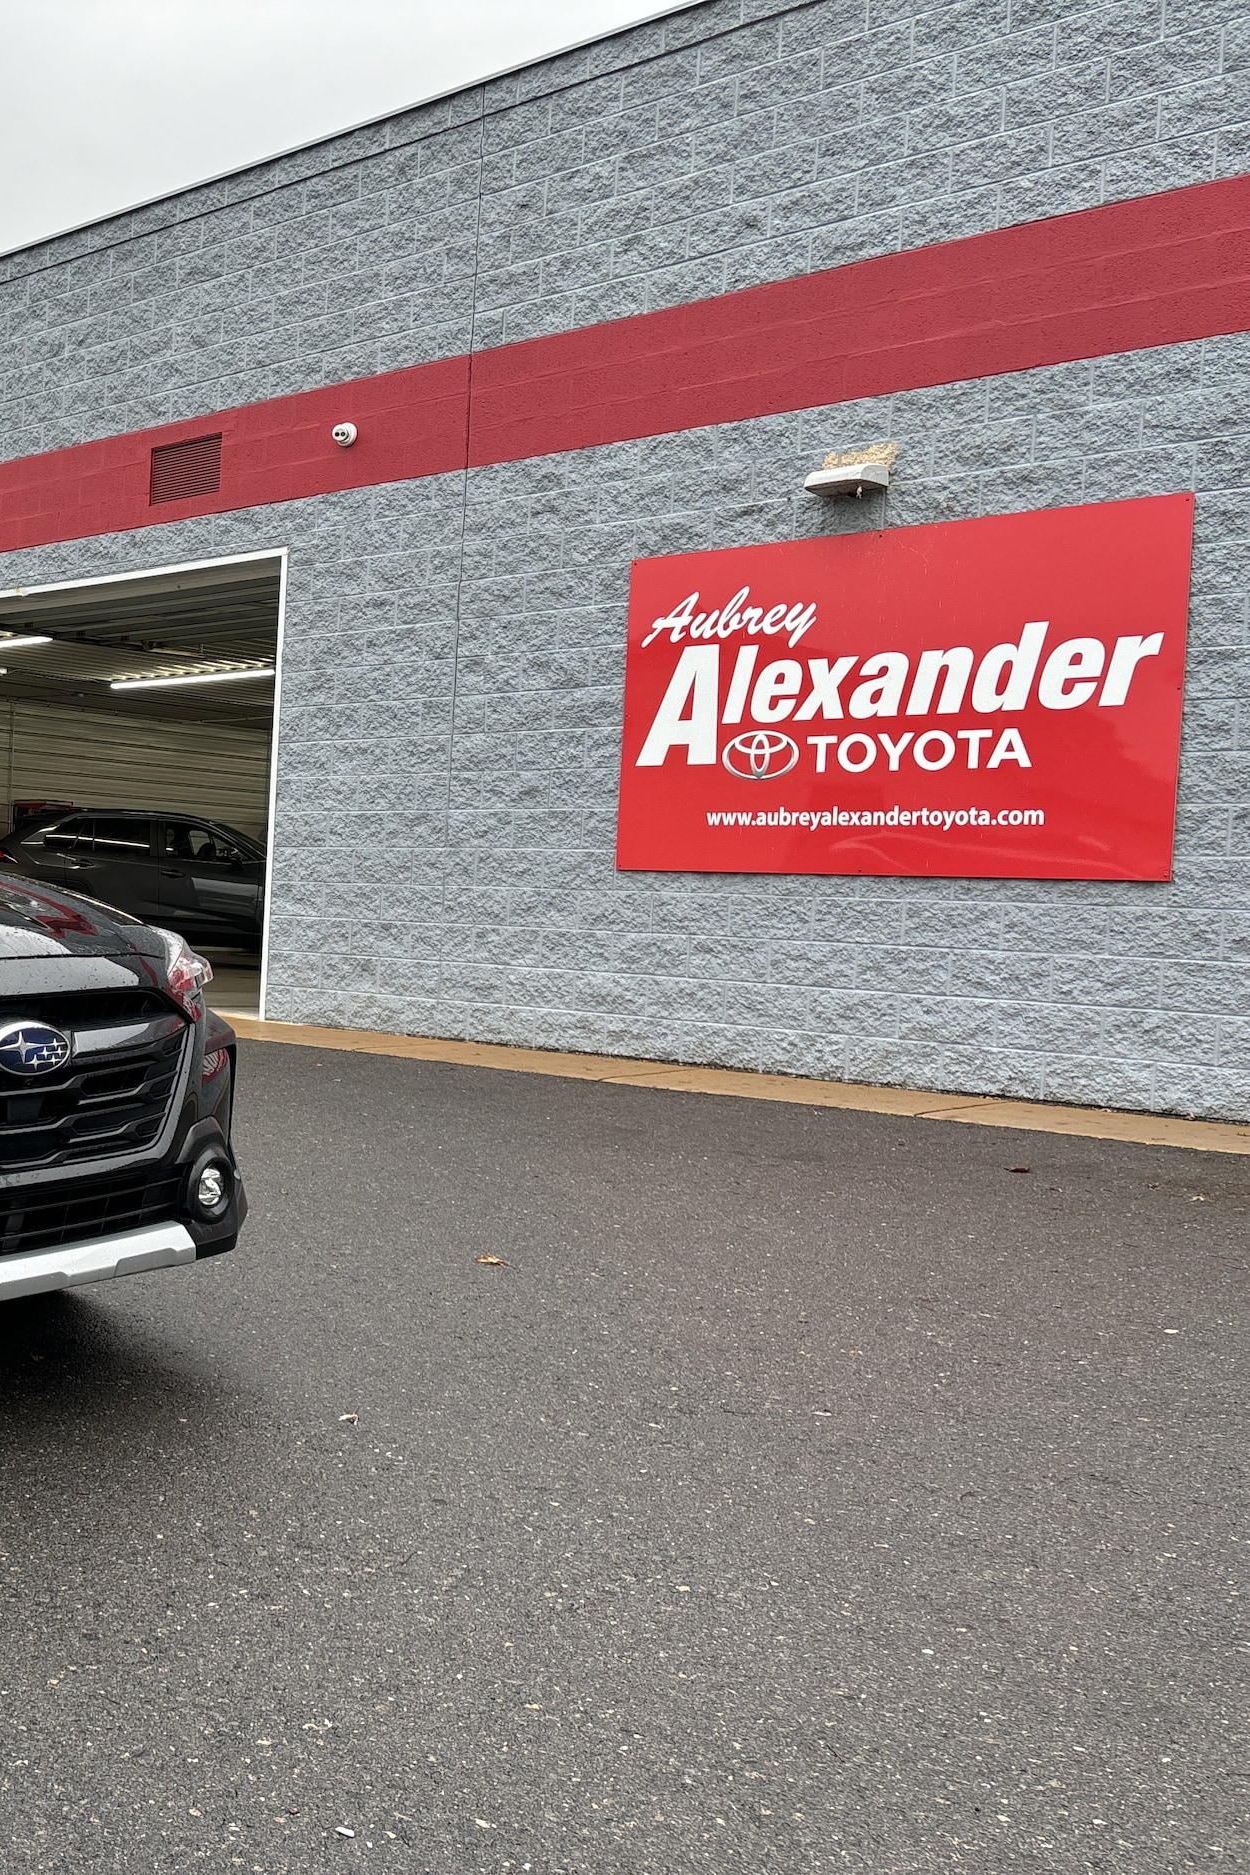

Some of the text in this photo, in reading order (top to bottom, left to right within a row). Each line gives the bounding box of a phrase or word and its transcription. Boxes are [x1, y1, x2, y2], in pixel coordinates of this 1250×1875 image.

[641, 585, 817, 649] Aubrey
[635, 620, 1165, 767] Alexander
[806, 727, 1032, 773] TOYOTA
[706, 805, 1045, 831] www.aubreyalexandertoyota.com
